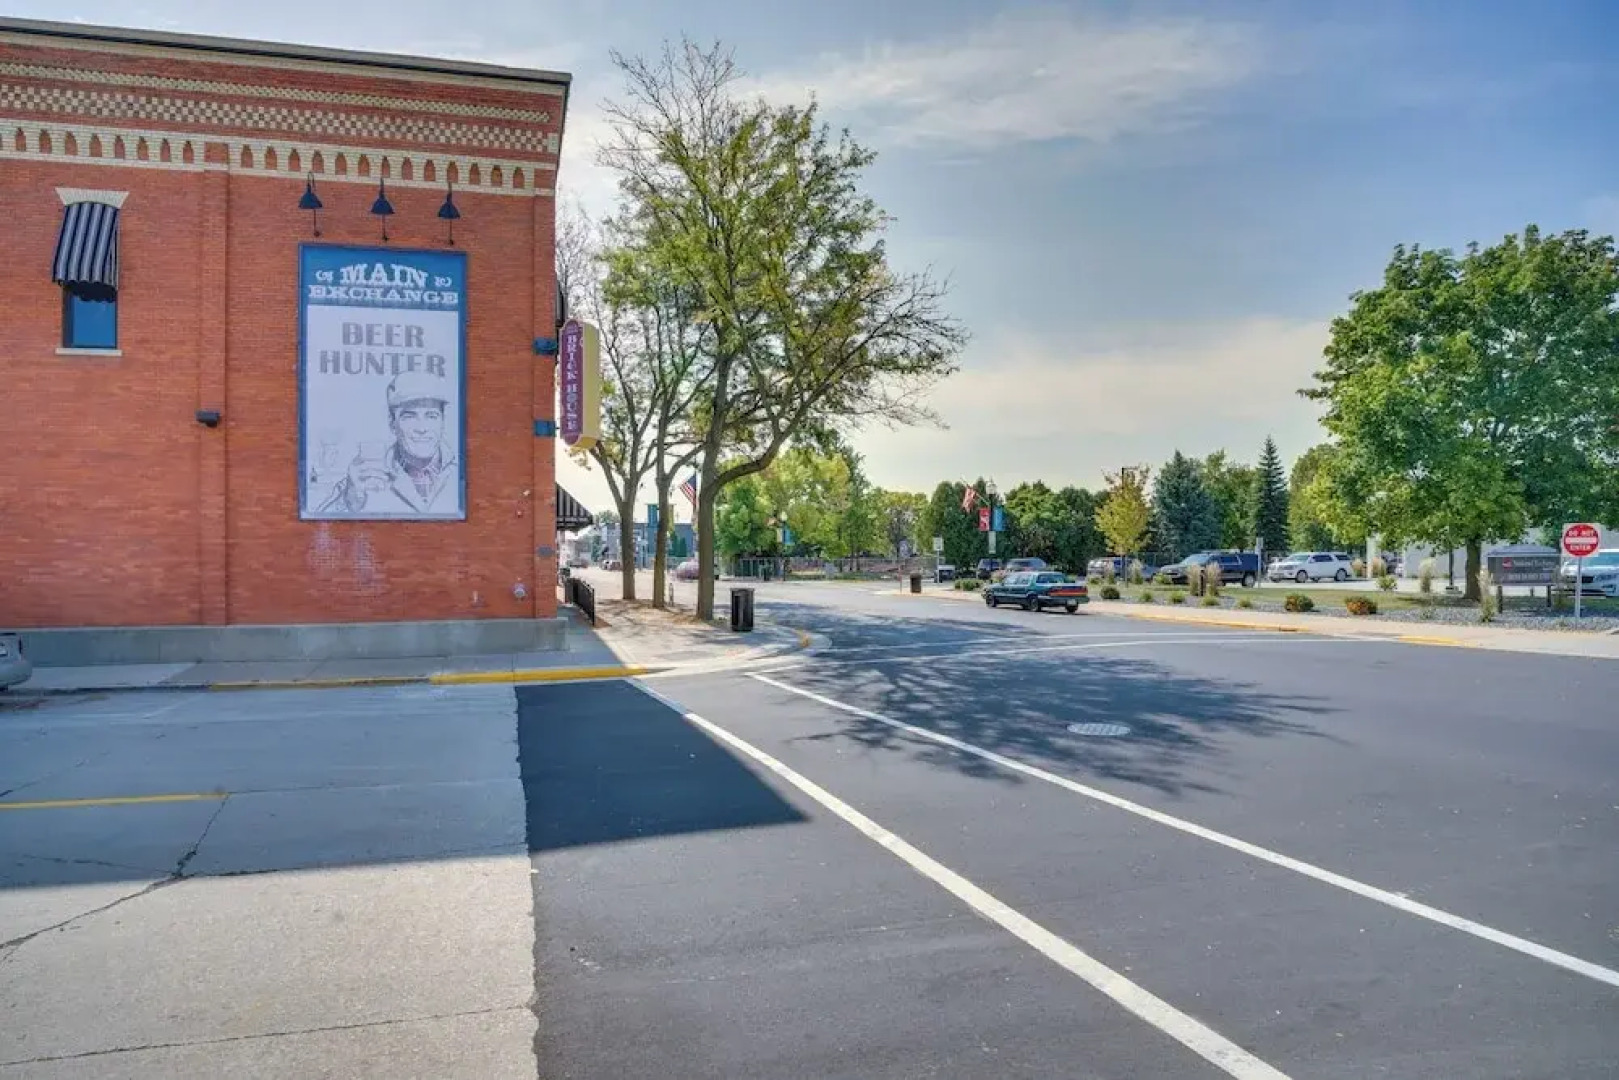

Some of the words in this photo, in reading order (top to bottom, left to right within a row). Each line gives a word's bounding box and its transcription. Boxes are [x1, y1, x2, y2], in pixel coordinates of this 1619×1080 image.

[340, 263, 428, 288] MAIN
[308, 284, 459, 304] EXCHANGE
[342, 321, 425, 348] BEER
[319, 350, 446, 377] HUNTER
